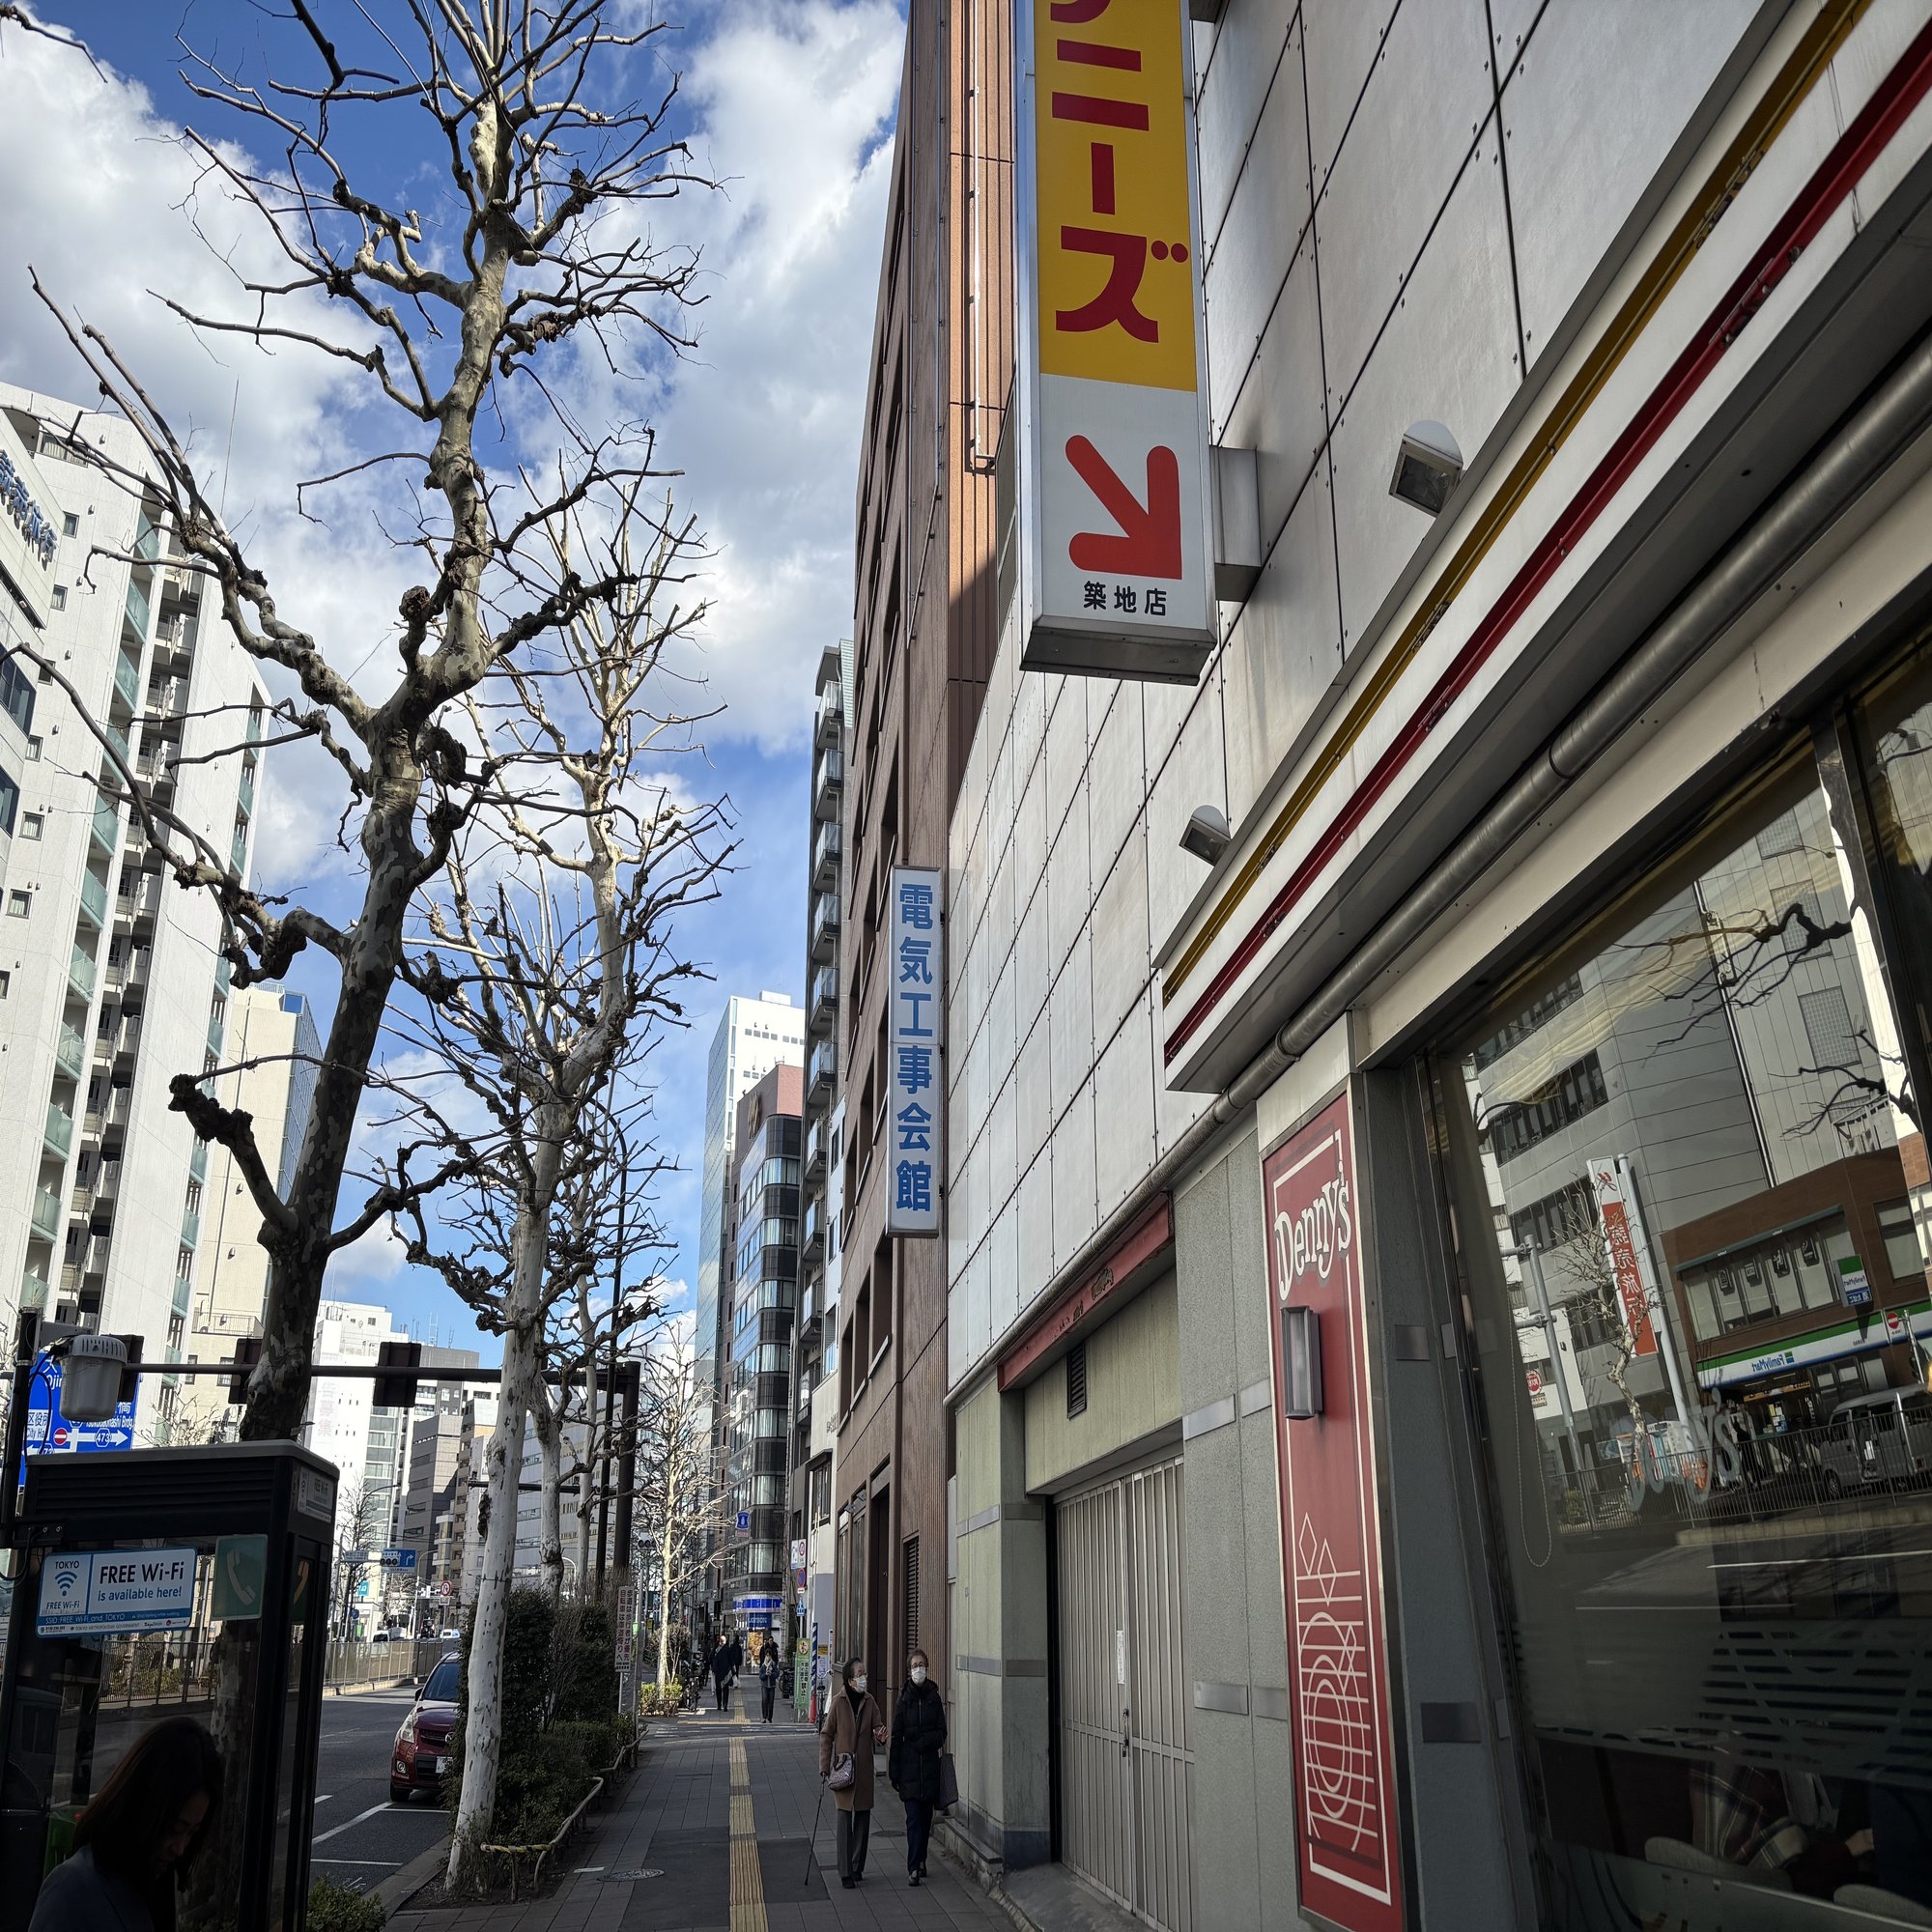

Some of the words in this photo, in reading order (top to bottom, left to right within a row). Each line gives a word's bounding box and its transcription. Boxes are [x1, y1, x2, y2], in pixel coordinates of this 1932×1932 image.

[1050, 0, 1189, 344] ニーズ
[1083, 581, 1167, 616] 築地店
[896, 883, 933, 1212] 電気工事会館
[1274, 1160, 1351, 1300] Denny's
[97, 1433, 109, 1443] 473
[55, 1560, 80, 1570] TOKYO
[99, 1565, 136, 1584] FREE
[142, 1561, 185, 1582] Wi-Fi
[45, 1601, 61, 1610] FREE
[63, 1600, 80, 1609] Wi-Fi
[98, 1590, 105, 1602] is
[108, 1587, 153, 1601] available
[156, 1586, 182, 1599] here!
